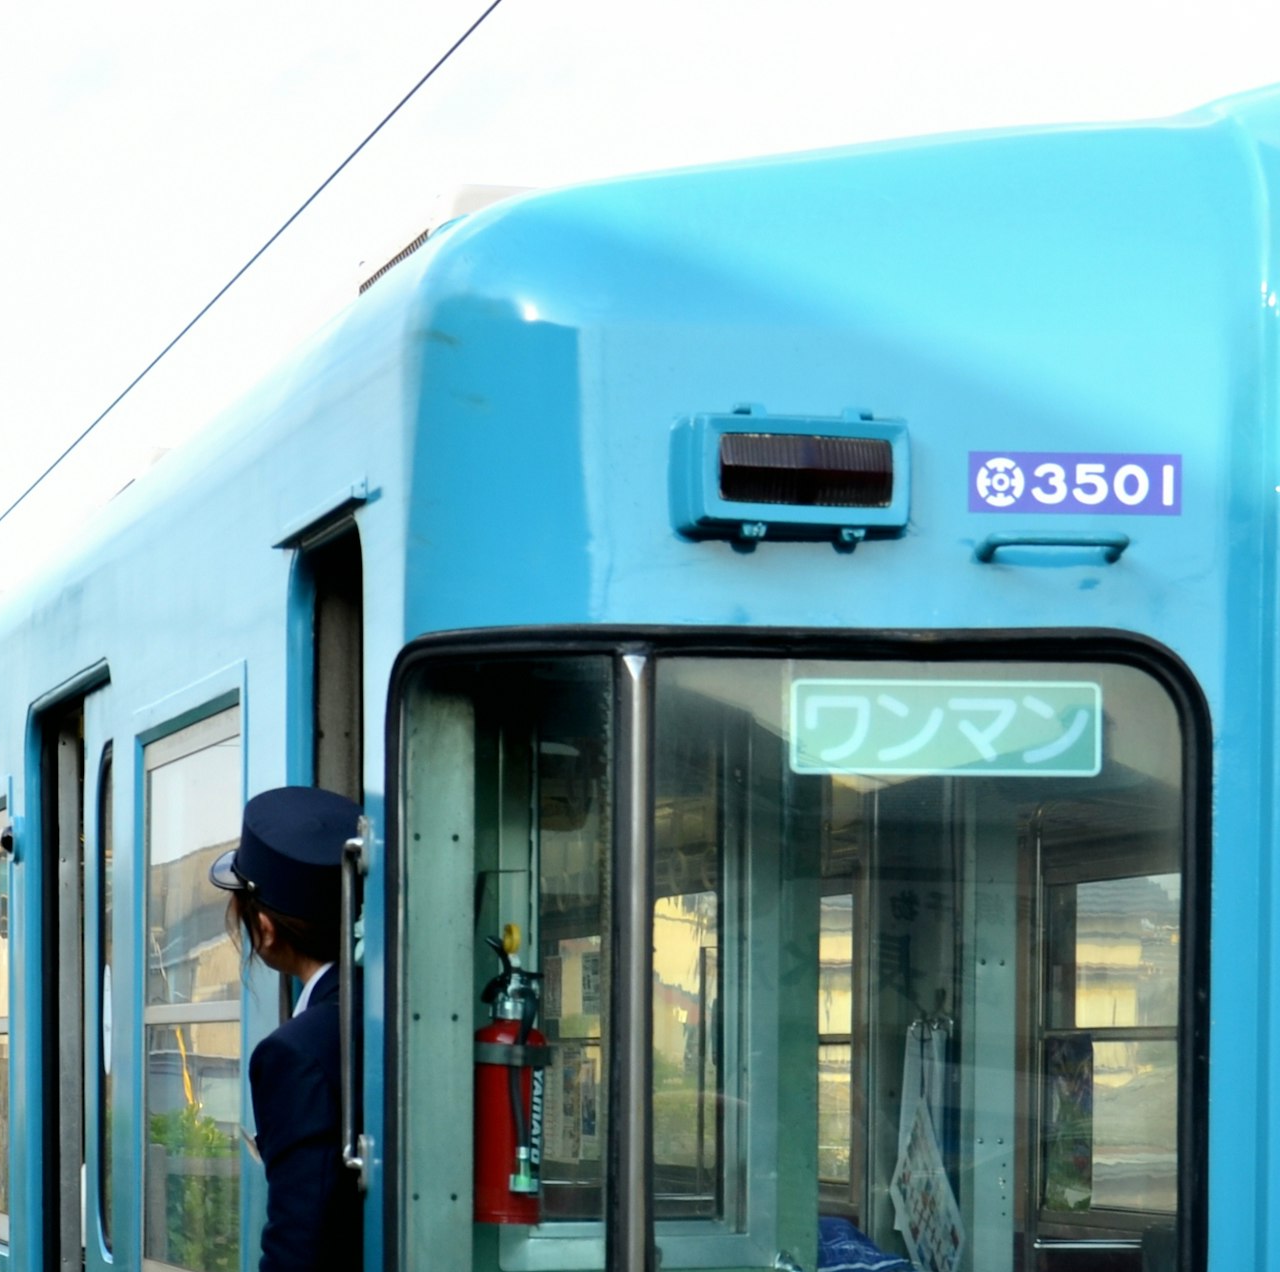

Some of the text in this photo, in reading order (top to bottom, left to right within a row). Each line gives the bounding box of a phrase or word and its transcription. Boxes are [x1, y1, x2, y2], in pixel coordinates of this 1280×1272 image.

[1031, 463, 1174, 506] 3501
[804, 694, 1090, 764] ワンマン
